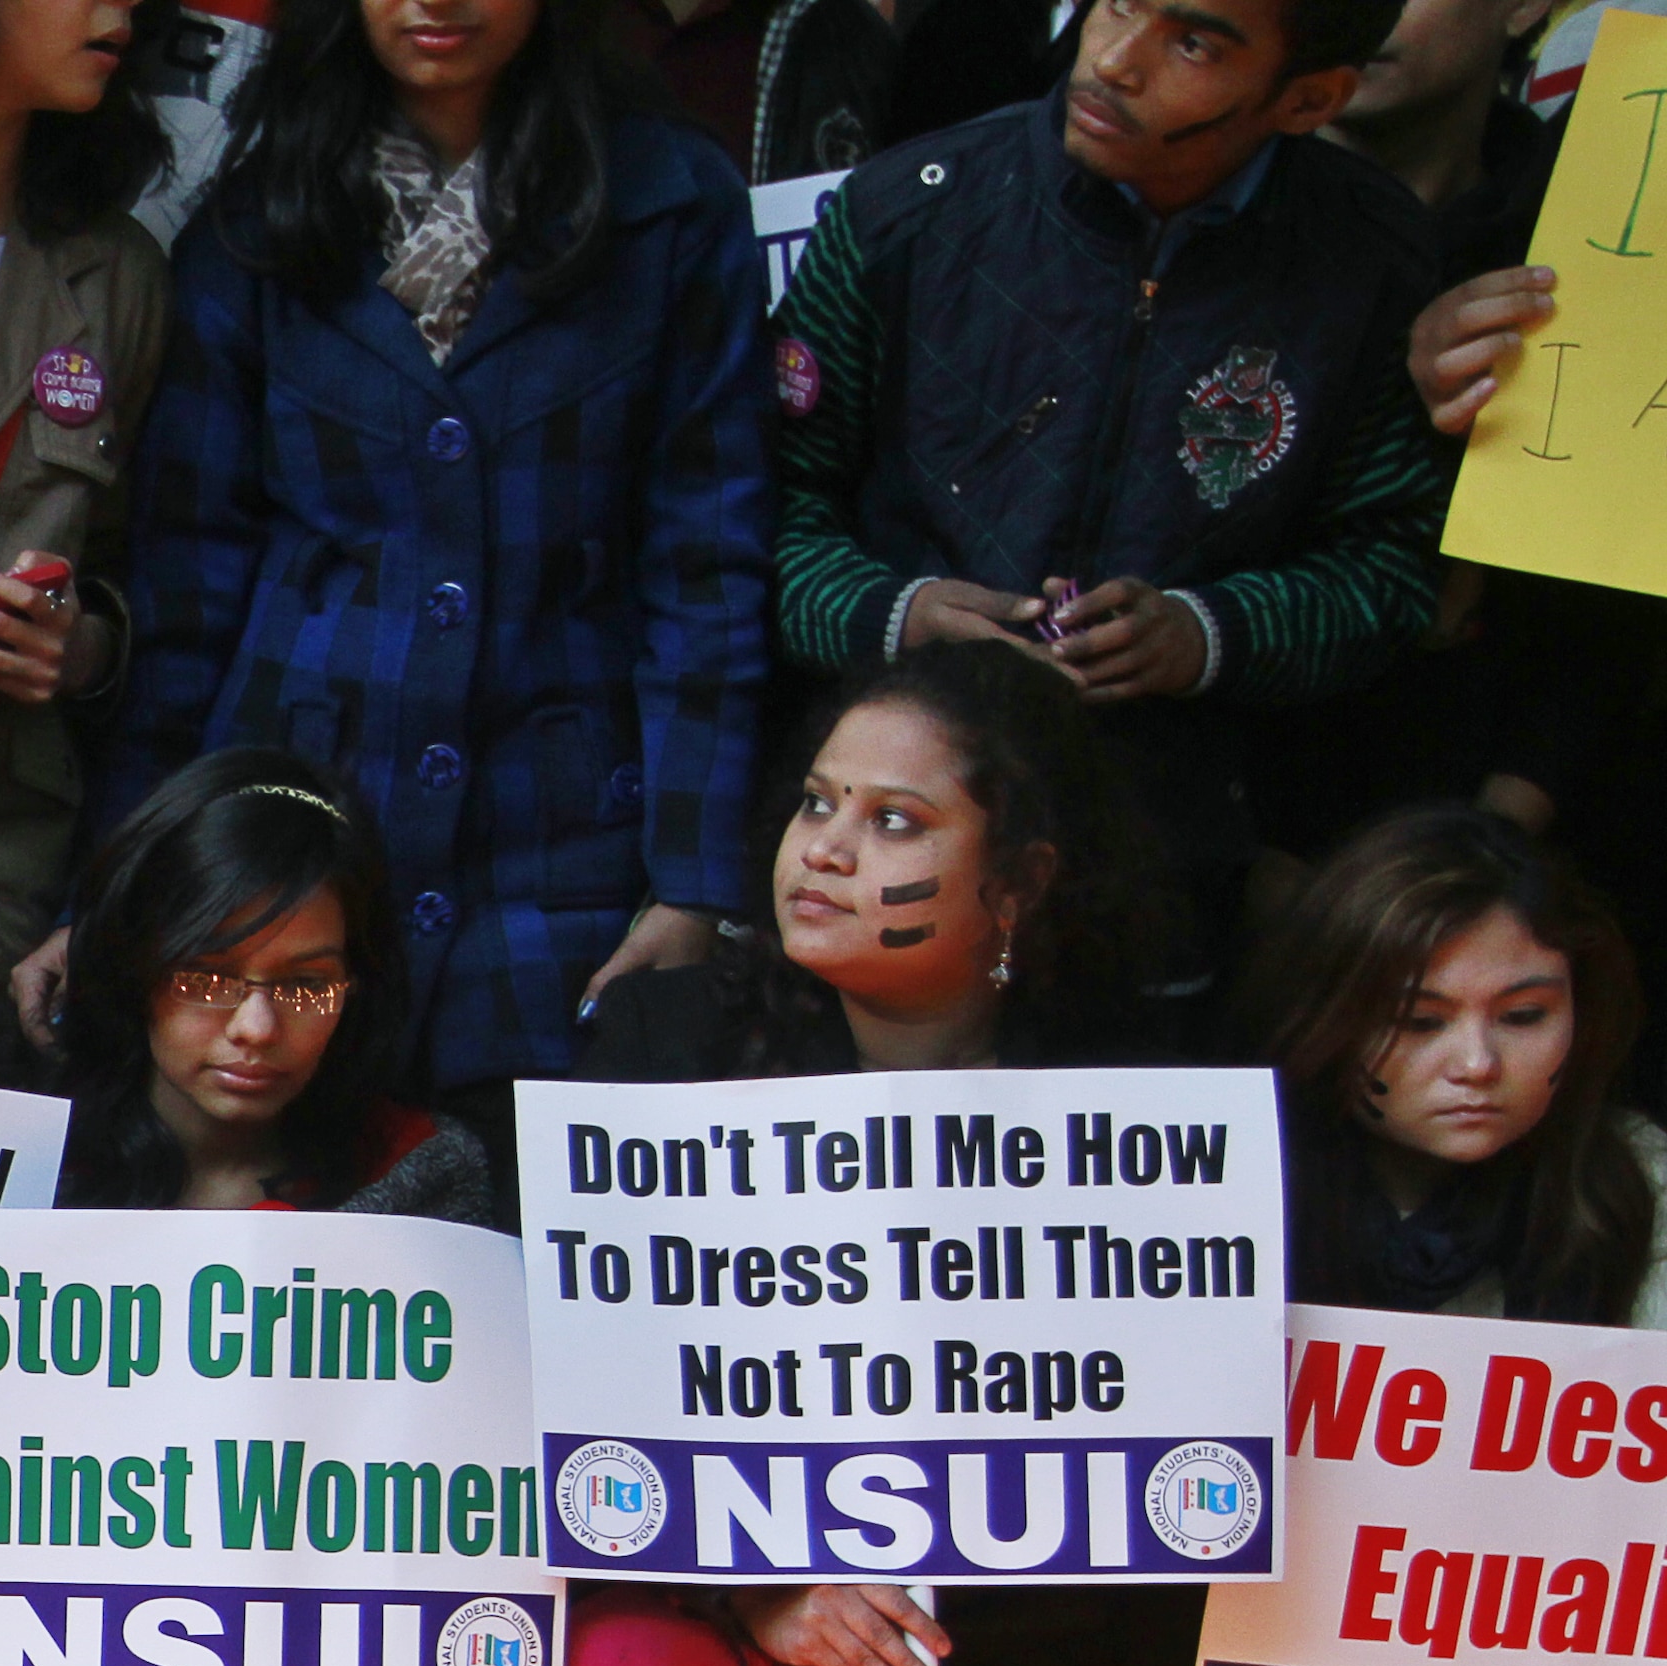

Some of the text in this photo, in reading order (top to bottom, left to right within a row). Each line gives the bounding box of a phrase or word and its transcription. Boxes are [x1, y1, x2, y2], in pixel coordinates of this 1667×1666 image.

[568, 1113, 1227, 1197] Don't Tell Me How
[546, 1226, 1254, 1307] To Dress Tell Them
[189, 1264, 452, 1383] Crime
[680, 1340, 1124, 1420] Not To Rape
[1285, 1338, 1446, 1466] We
[215, 1440, 539, 1557] Women
[559, 1443, 663, 1550] NATIONAL STUDENTS' UNION OF INDIA
[693, 1452, 1128, 1569] NSUI
[1148, 1444, 1258, 1552] NATIONAL STUDENTS' UNION OF INDIA
